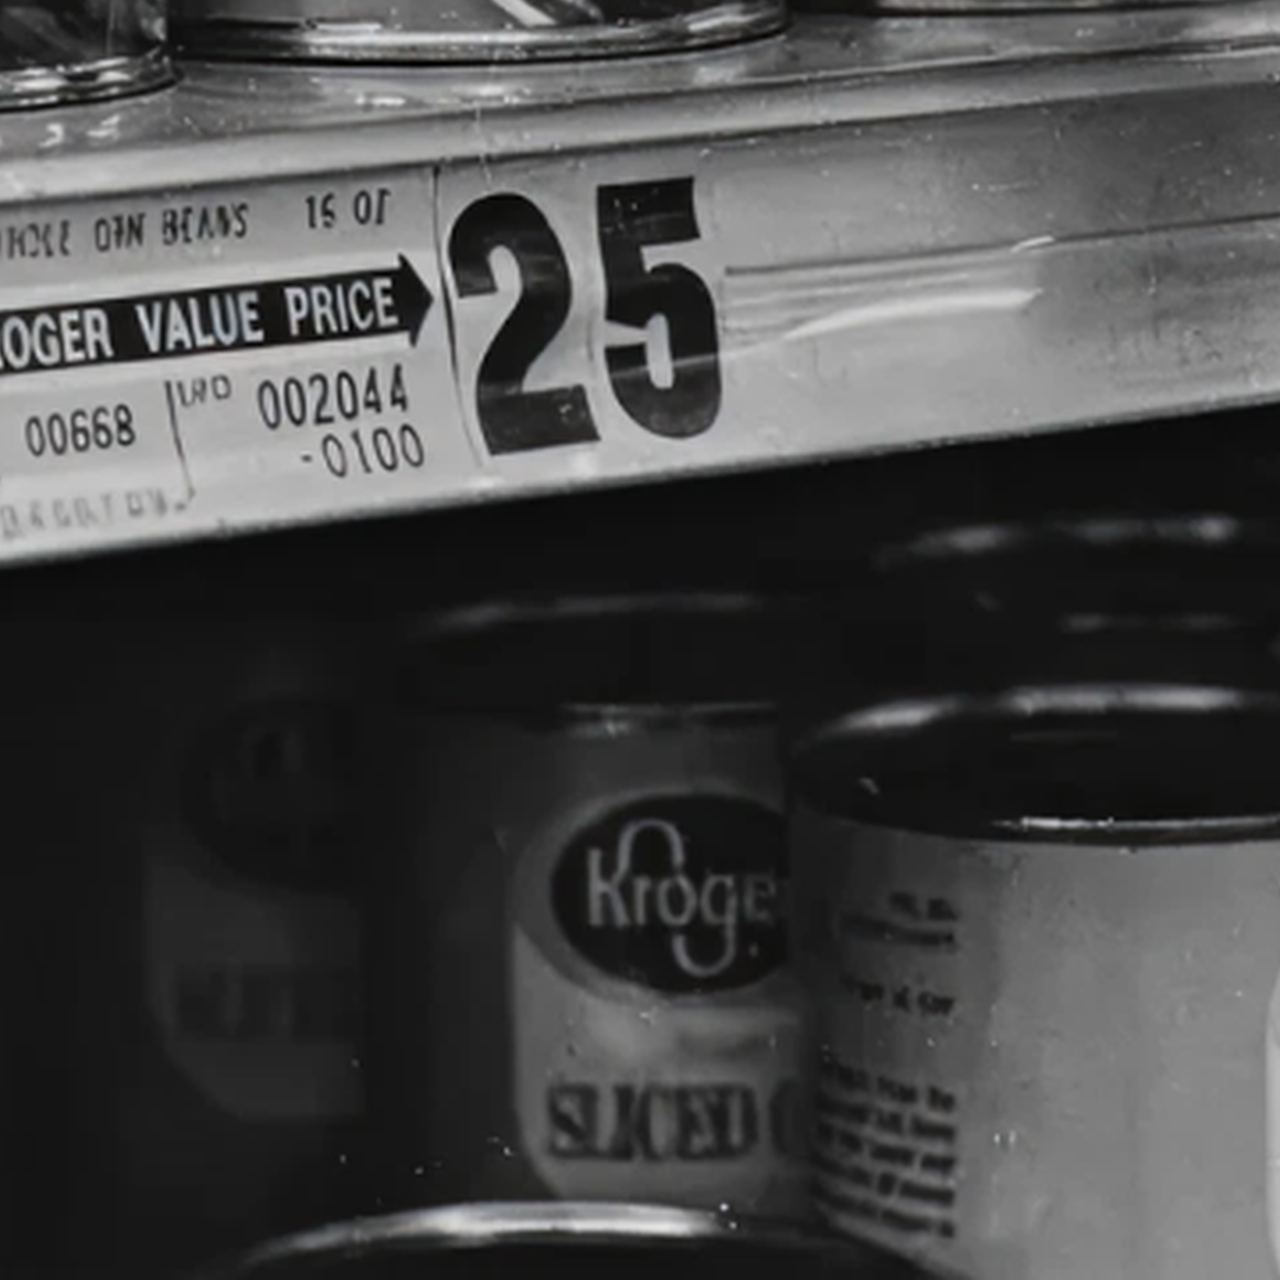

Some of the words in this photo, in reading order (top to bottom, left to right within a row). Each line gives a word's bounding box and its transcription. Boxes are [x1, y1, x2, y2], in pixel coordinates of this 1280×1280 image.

[162, 204, 249, 247] BEANS
[136, 291, 264, 353] VALUE
[285, 277, 400, 337] PRICE
[446, 176, 721, 456] 25
[25, 404, 136, 458] 00668
[257, 364, 410, 431] 002044
[588, 819, 777, 978] Kroge
